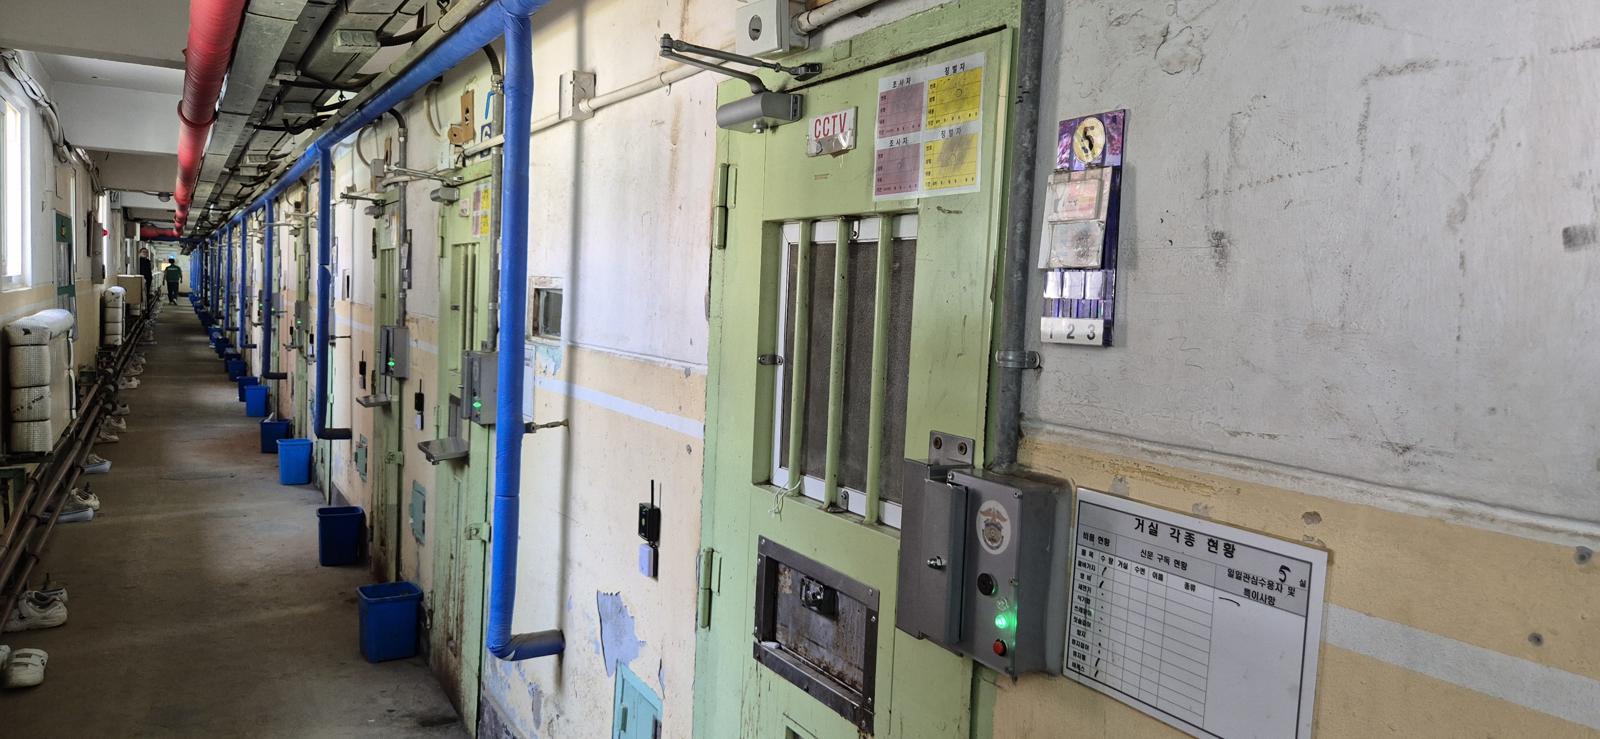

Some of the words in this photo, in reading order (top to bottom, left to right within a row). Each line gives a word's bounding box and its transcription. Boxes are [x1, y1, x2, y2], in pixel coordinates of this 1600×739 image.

[814, 112, 848, 139] CCTV
[1066, 324, 1076, 340] 2
[1086, 324, 1096, 340] 3
[1097, 536, 1110, 547] 현황
[1134, 517, 1159, 537] 거실
[1169, 527, 1196, 547] 각종
[1207, 538, 1236, 559] 현황
[1117, 560, 1128, 570] 거실
[1140, 549, 1154, 560] 신문
[1157, 553, 1170, 565] 구독
[1173, 559, 1188, 571] 현황
[1152, 571, 1164, 582] 이름
[1278, 564, 1291, 583] 5
[1184, 582, 1196, 592] 종류
[1227, 568, 1283, 593] 일일관심수용자
[1287, 586, 1296, 598] 및
[1299, 578, 1307, 588] 실
[1243, 587, 1276, 607] 특이사항
